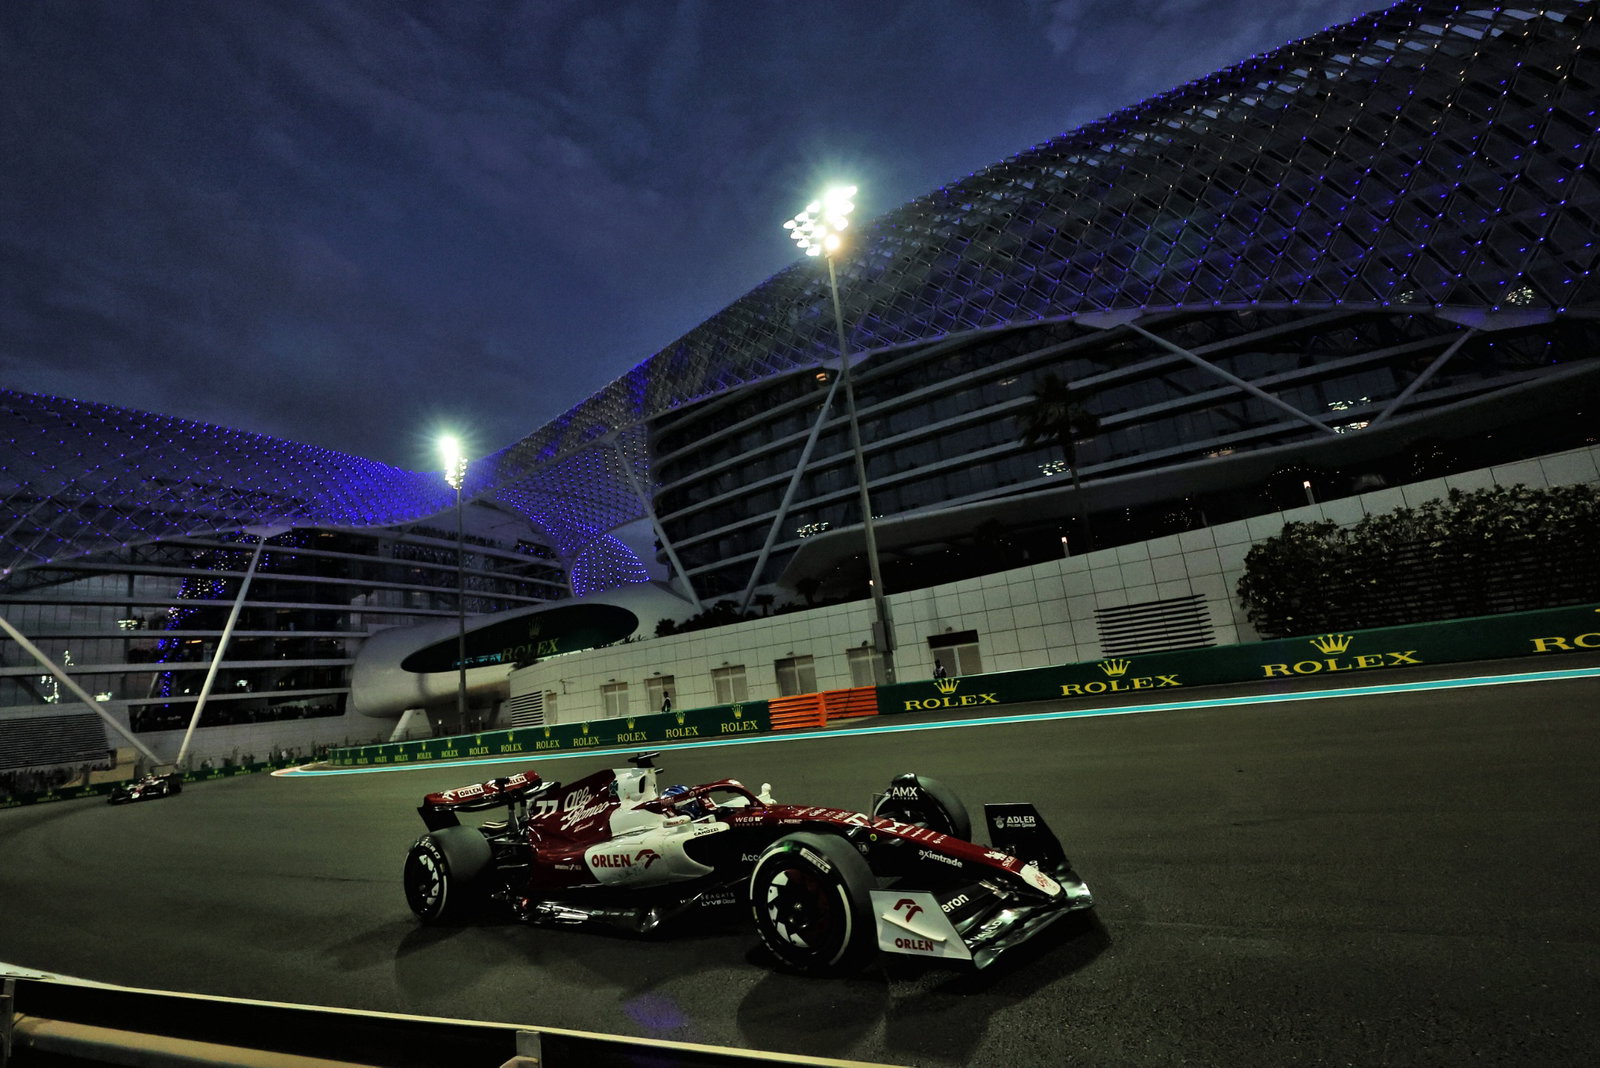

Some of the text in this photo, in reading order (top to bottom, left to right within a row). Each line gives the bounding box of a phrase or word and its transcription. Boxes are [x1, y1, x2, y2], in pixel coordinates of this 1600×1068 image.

[1263, 650, 1423, 678] ROLEX
[1060, 674, 1183, 697] ROLEX
[904, 692, 1000, 711] ROLEX
[665, 726, 699, 738] ROLEX
[721, 720, 759, 733] ROLEX
[573, 736, 600, 747] ROLEX
[617, 731, 648, 743] ROLEX
[501, 743, 522, 752] ROLEX
[536, 739, 560, 749] ROLEX
[441, 749, 459, 758] ROLEX
[469, 746, 489, 755] ROLEX
[459, 787, 482, 797] ORLEN
[892, 786, 918, 797] AMX
[531, 800, 559, 820] 77
[560, 801, 610, 831] Romeo
[1006, 815, 1036, 824] ADLER
[591, 854, 631, 868] ORLEN
[741, 852, 761, 862] Acc
[918, 849, 963, 868] aximtrade
[895, 937, 934, 952] ORLEN
